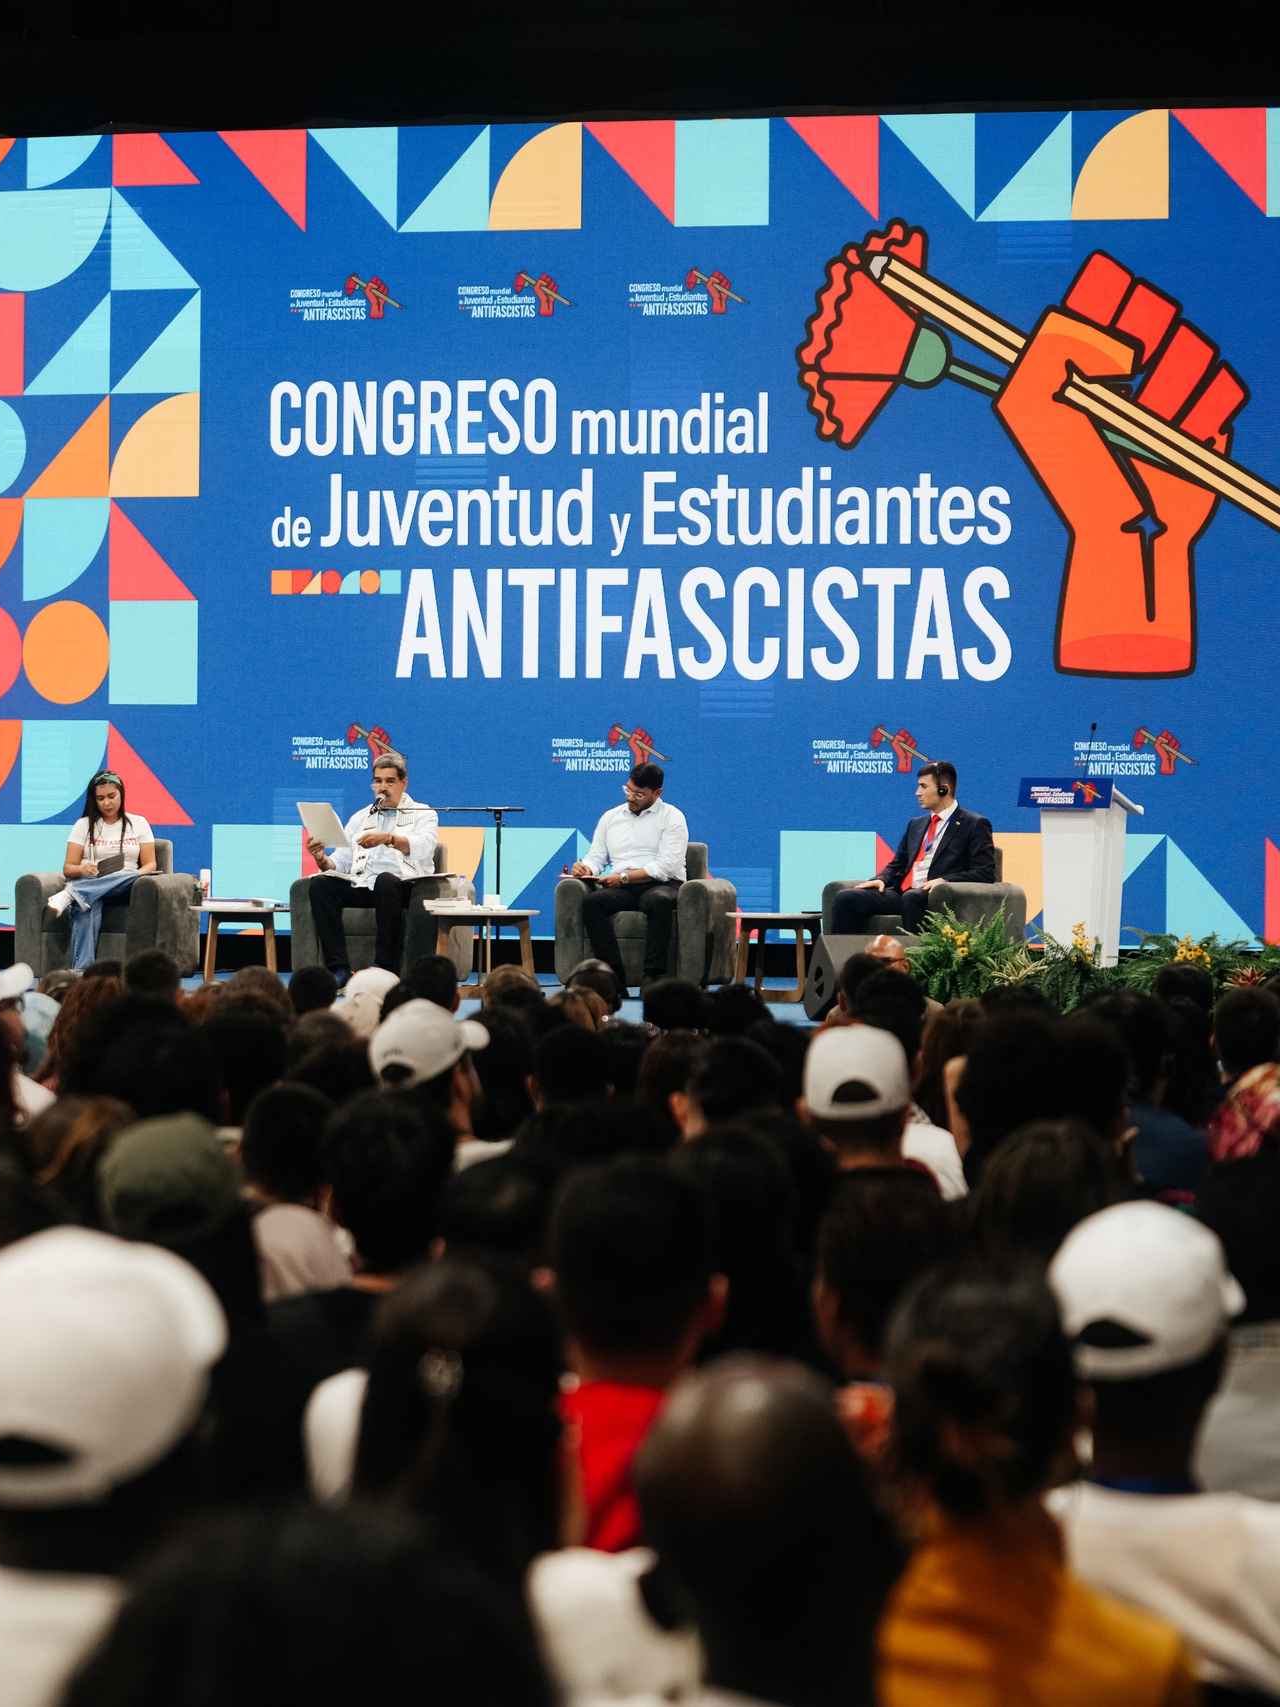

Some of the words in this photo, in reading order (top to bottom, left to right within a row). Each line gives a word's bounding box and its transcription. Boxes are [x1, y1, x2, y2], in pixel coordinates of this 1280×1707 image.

[290, 288, 321, 298] CONGRESO
[457, 286, 490, 295] CONGRESO
[628, 283, 661, 293] CONGRESO
[295, 298, 325, 307] Juventud
[328, 297, 366, 307] Estudiantes
[463, 296, 493, 305] Juventud
[497, 294, 536, 304] Estudiantes
[634, 293, 665, 302] Juventud
[668, 292, 708, 302] Estudiantes
[303, 307, 366, 321] ANTIFASCISTAS
[471, 305, 536, 318] ANTIFASCISTAS
[642, 302, 708, 316] ANTIFASCISTAS
[270, 378, 557, 457] CONGRESO
[571, 392, 768, 455] mundial
[271, 506, 311, 548] de
[320, 468, 593, 547] Juventud
[610, 513, 631, 557] y
[643, 466, 1012, 546] Estudiantes
[395, 566, 1012, 682] ANTIFASCISTAS
[292, 736, 323, 746] CONGRESO
[551, 738, 583, 748] CONGRESO
[812, 740, 846, 749] CONGRESO
[297, 746, 326, 755] Juventud
[330, 746, 369, 756] Estudiantes
[557, 748, 587, 757] Juventud
[591, 748, 630, 758] Estudiantes
[818, 750, 849, 759] Juventud
[853, 750, 893, 759] Estudiantes
[1115, 752, 1156, 761] Estudiantes
[305, 756, 369, 770] ANTIFASCISTAS
[565, 758, 630, 772] ANTIFASCISTAS
[827, 760, 893, 773] ANTIFASCISTAS
[1088, 762, 1156, 776] ANTIFASCISTAS
